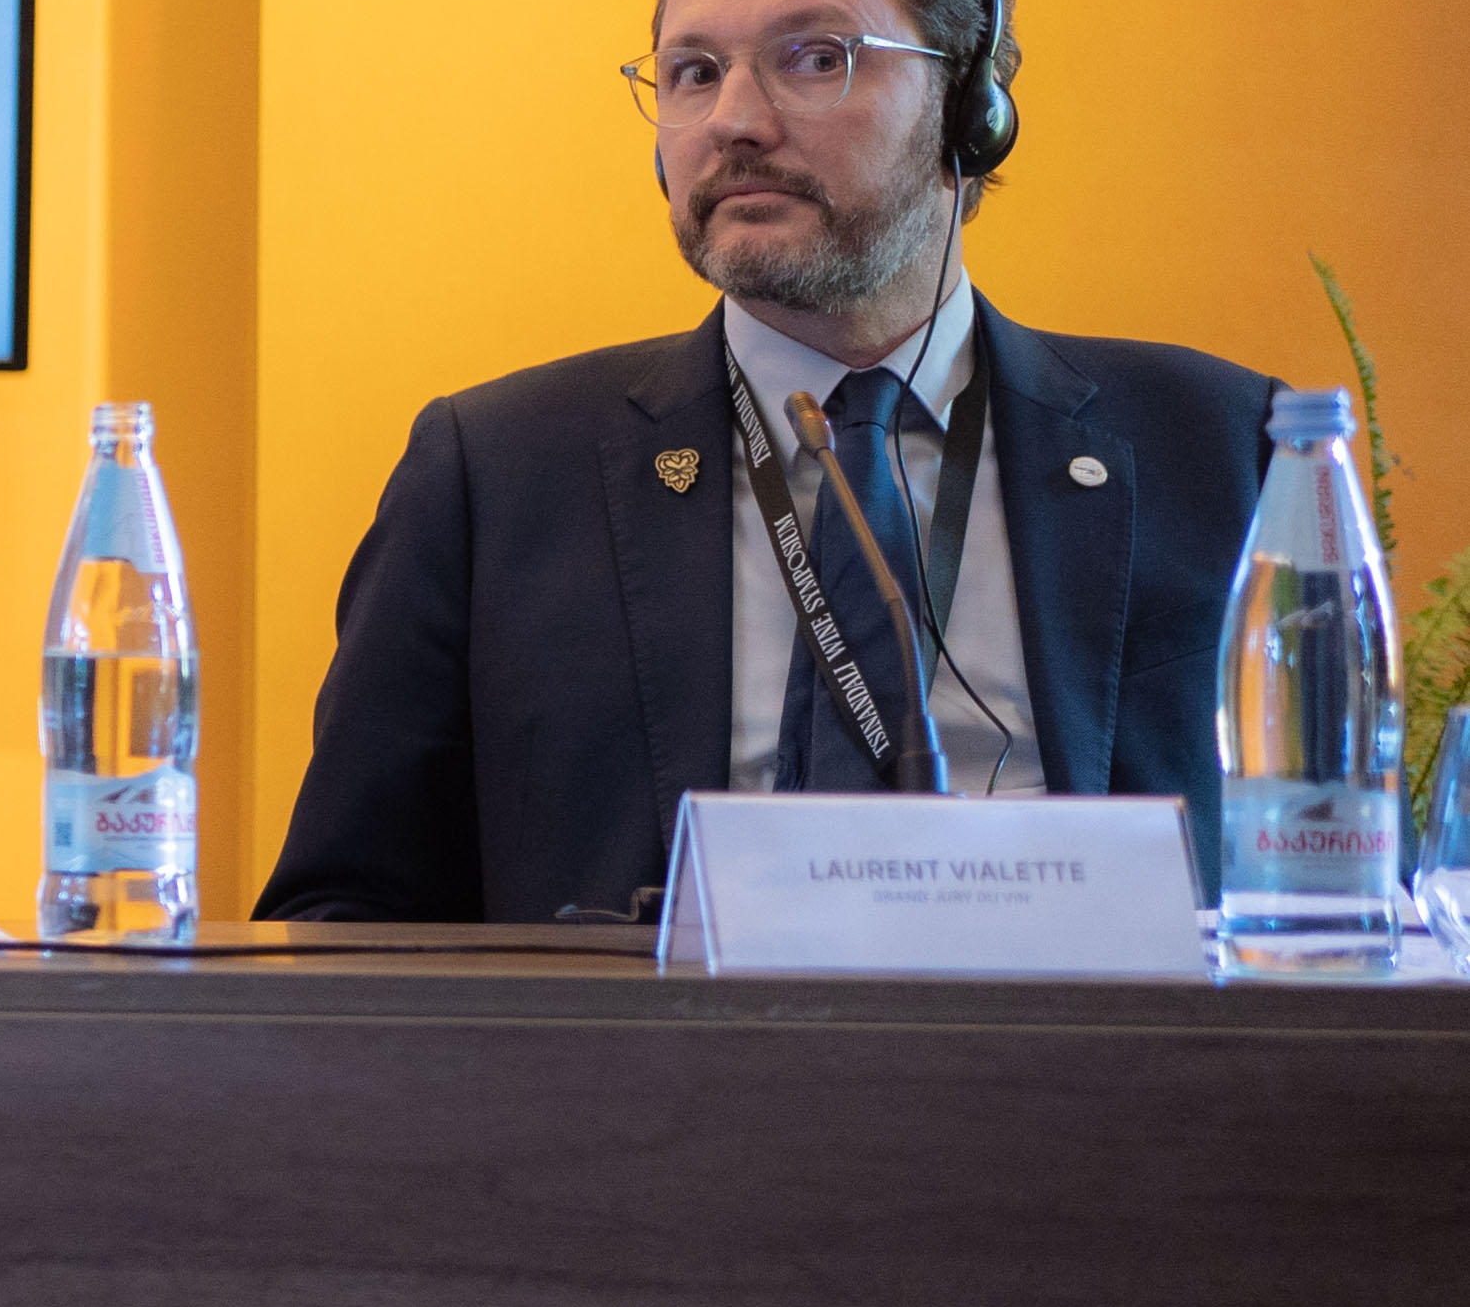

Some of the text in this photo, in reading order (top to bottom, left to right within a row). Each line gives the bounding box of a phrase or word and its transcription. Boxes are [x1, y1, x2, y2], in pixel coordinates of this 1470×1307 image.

[731, 381, 773, 469] TSINANDALI
[773, 511, 891, 760] TSINANDALI WINE SYMPOSIUM
[809, 859, 1086, 883] LAURENT VIALETTE
